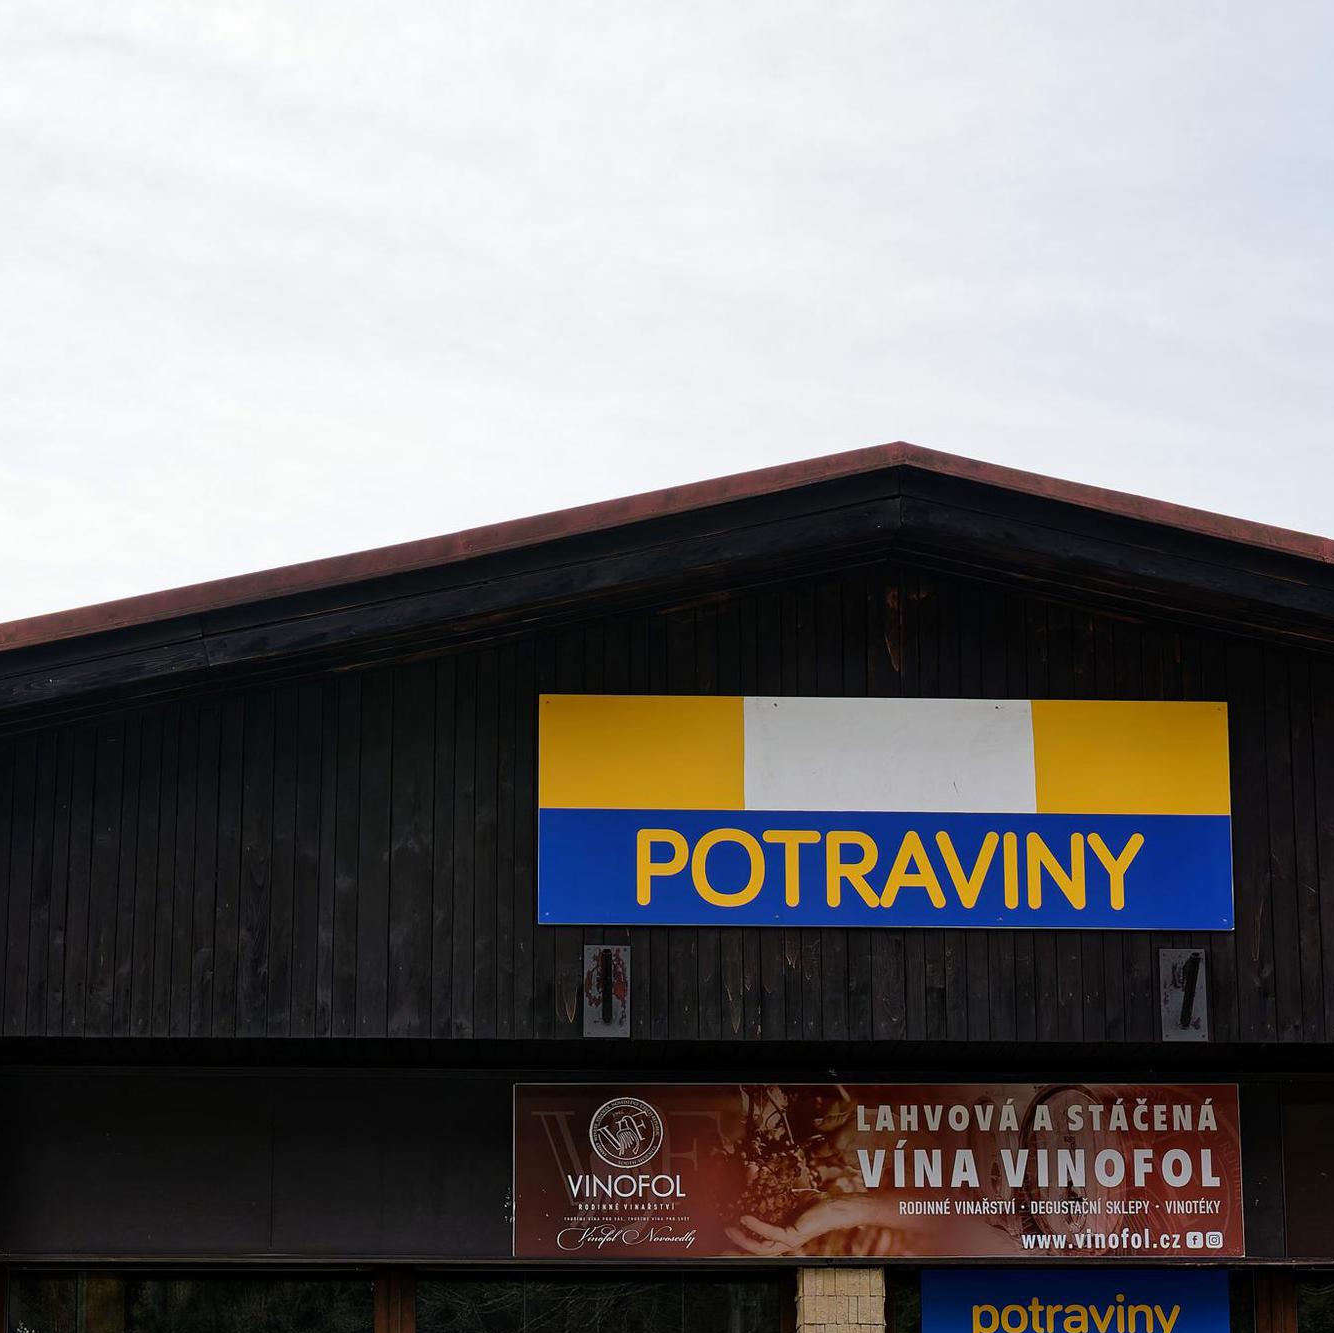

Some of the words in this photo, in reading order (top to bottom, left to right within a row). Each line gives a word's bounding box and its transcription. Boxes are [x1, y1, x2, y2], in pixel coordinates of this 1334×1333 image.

[637, 830, 1143, 908] POTRAVINY
[856, 1098, 1019, 1132] LAHVOVÁ
[1033, 1104, 1053, 1132] A
[1067, 1098, 1218, 1132] STÁČENÁ
[857, 1139, 980, 1188] VÍNA
[1000, 1148, 1221, 1188] VINOFOL
[567, 1174, 686, 1198] VINOFOL
[578, 1202, 619, 1211] RODINNÉ
[623, 1202, 675, 1211] VINAŘSTVÍ
[899, 1198, 951, 1215] RODINNÉ
[954, 1198, 1016, 1215] VINAŘSTVÍ
[1031, 1198, 1102, 1215] DEGUSTAČNÍ
[1106, 1200, 1150, 1215] SKLEPY
[1165, 1198, 1221, 1215] VINOTÉKY
[557, 1224, 622, 1250] Vinofol
[623, 1226, 697, 1249] Novosedly
[1022, 1228, 1181, 1249] www.vinofol.cz
